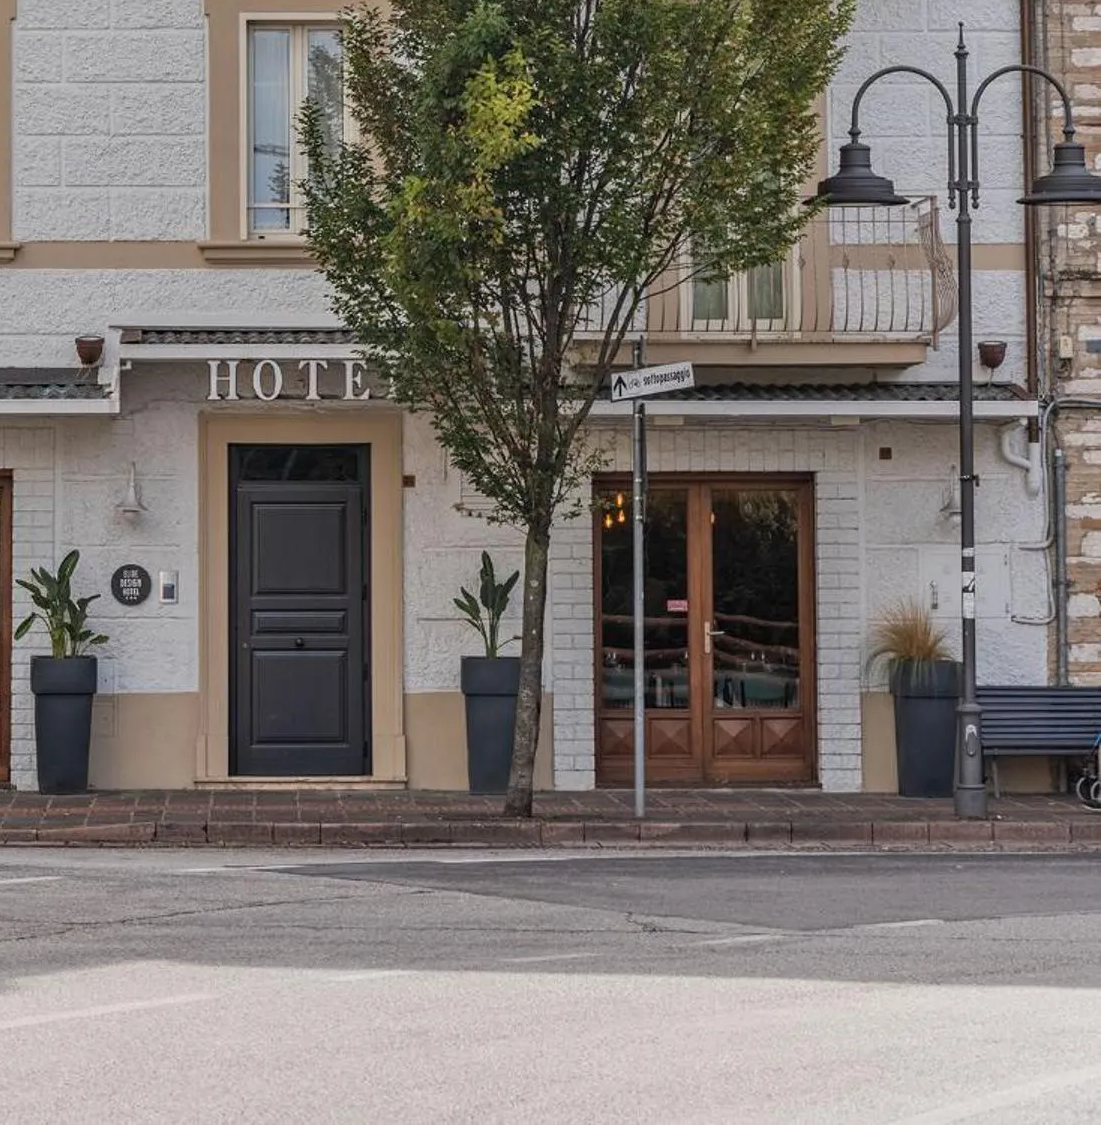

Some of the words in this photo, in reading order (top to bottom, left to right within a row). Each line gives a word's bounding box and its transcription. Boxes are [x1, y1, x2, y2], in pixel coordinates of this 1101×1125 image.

[206, 359, 399, 401] HOTE
[643, 368, 690, 385] sottopassaggio
[120, 578, 142, 587] DESIGN
[122, 587, 139, 596] HOTEL
